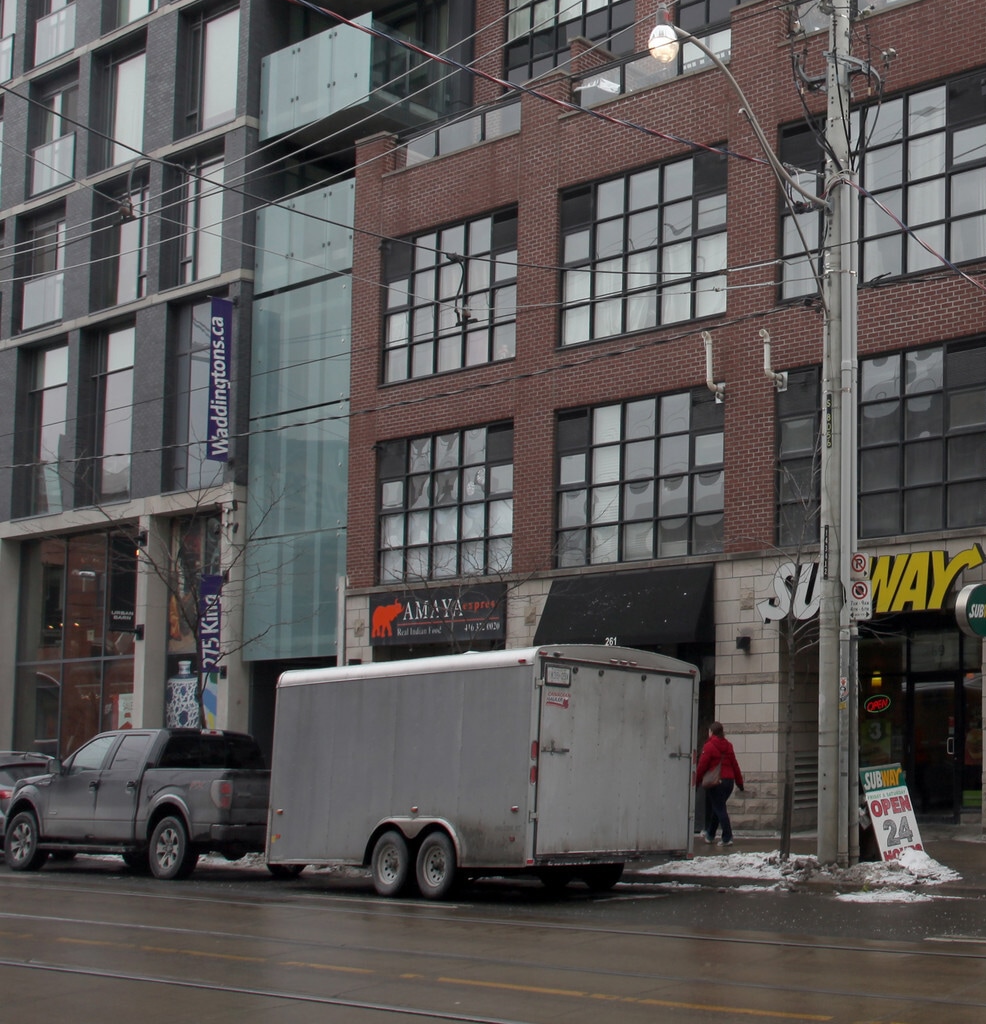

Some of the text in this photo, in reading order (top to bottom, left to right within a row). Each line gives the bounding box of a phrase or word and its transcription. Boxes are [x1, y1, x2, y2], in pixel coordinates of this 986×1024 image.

[210, 316, 231, 456] Waddingtons.ca
[402, 598, 463, 621] AMAYA
[201, 594, 221, 669] 275 King
[605, 637, 617, 646] 261
[866, 698, 889, 711] OPEN
[864, 767, 902, 791] SUBWAY
[870, 794, 912, 818] OPEN
[882, 816, 914, 848] 24
